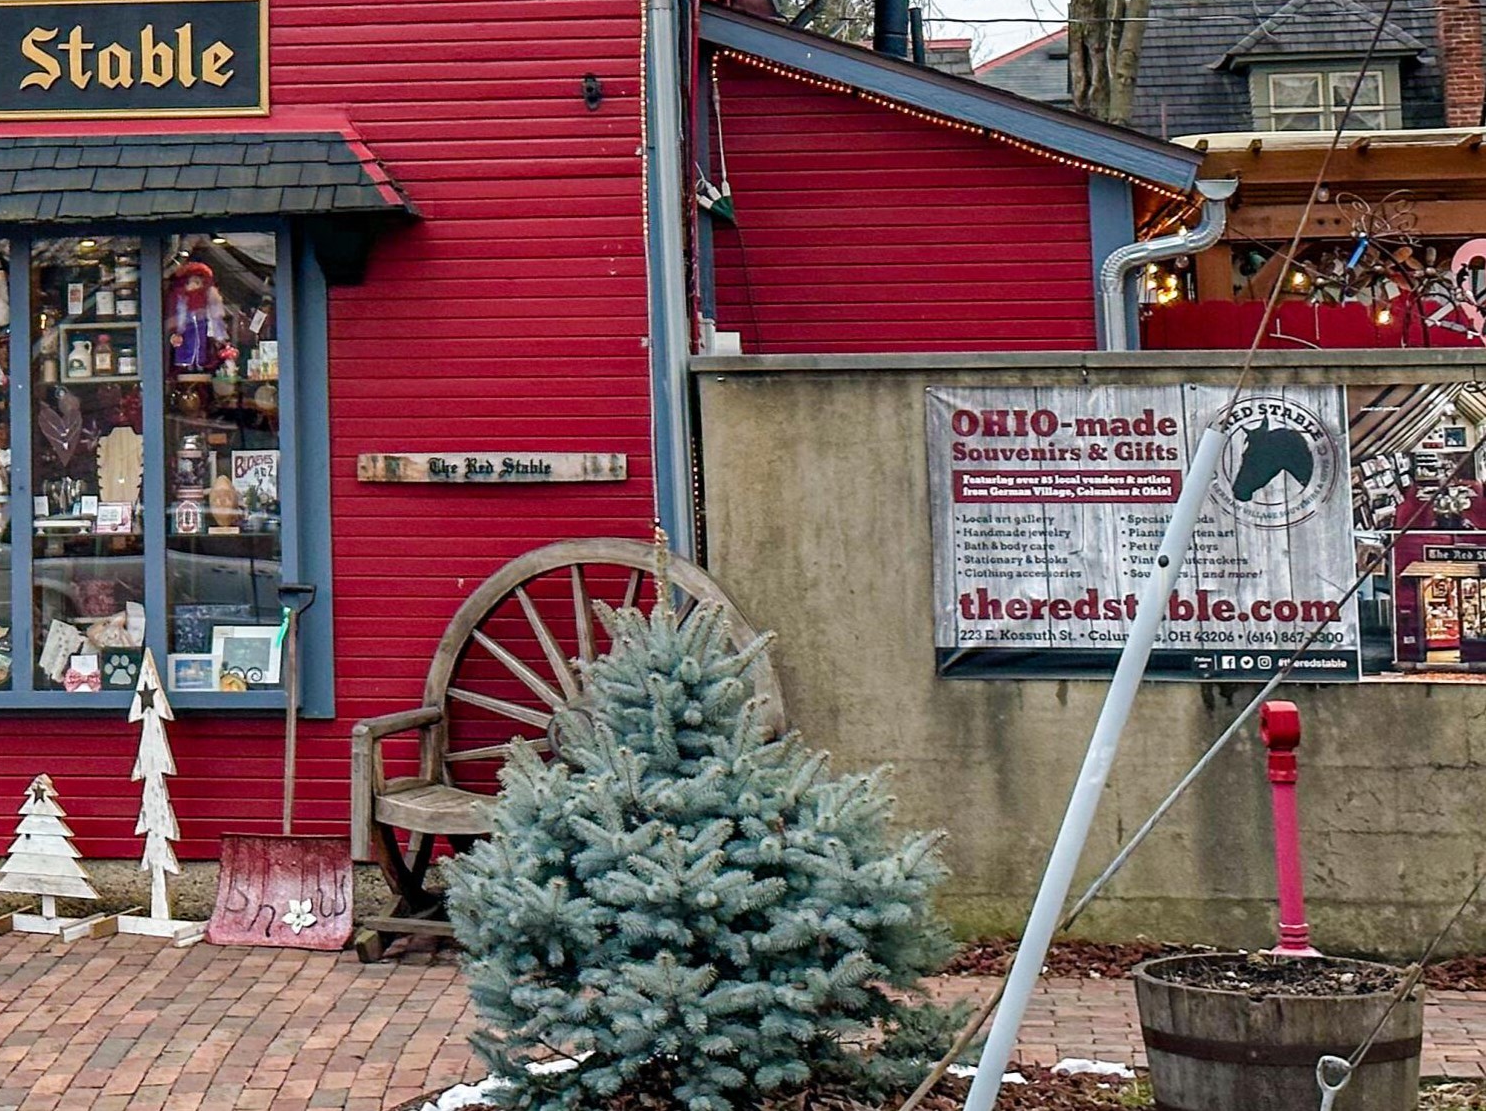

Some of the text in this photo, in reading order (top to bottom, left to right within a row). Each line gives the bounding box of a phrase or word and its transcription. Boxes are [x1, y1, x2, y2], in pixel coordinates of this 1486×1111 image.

[19, 22, 237, 92] Stable
[951, 408, 1178, 437] OHIO-made
[1257, 403, 1325, 443] STABLE
[952, 441, 1179, 462] Souvenirs & Gifts
[427, 457, 552, 479] The Red Stable
[962, 474, 1015, 486] Featuring
[1015, 476, 1040, 484] over
[1054, 474, 1081, 484] local
[1082, 474, 1125, 484] vendors
[1136, 474, 1172, 484] artists
[962, 486, 989, 496] from
[989, 486, 1032, 496] German
[1032, 486, 1076, 498] Village,
[1076, 486, 1130, 496] Columbus
[962, 514, 1056, 526] Local art gallery
[1127, 514, 1172, 525] Special
[963, 528, 1072, 539] Handmade jewelry
[1128, 528, 1165, 537] Plants
[1216, 529, 1235, 537] art
[964, 541, 990, 551] Bath
[991, 542, 999, 551] &
[1000, 541, 1028, 553] body
[1129, 541, 1148, 551] Pet
[964, 554, 1069, 566] Stationary & books
[1183, 555, 1249, 566] utcrackers
[1428, 549, 1449, 559] The
[1453, 549, 1474, 560] Red
[964, 568, 1082, 580] Clothing accessories
[1201, 569, 1225, 579] and
[1227, 569, 1264, 579] more!
[959, 587, 1342, 623] theredstble.com
[960, 630, 982, 640] 223
[985, 630, 999, 641] E.
[1000, 629, 1057, 641] Kossuth
[1059, 630, 1077, 641] St.
[1087, 629, 1166, 644] Colus,
[1167, 631, 1191, 642] OH
[1193, 631, 1234, 643] 43206
[1246, 630, 1278, 646] (614)
[1278, 658, 1348, 668] #teredstable
